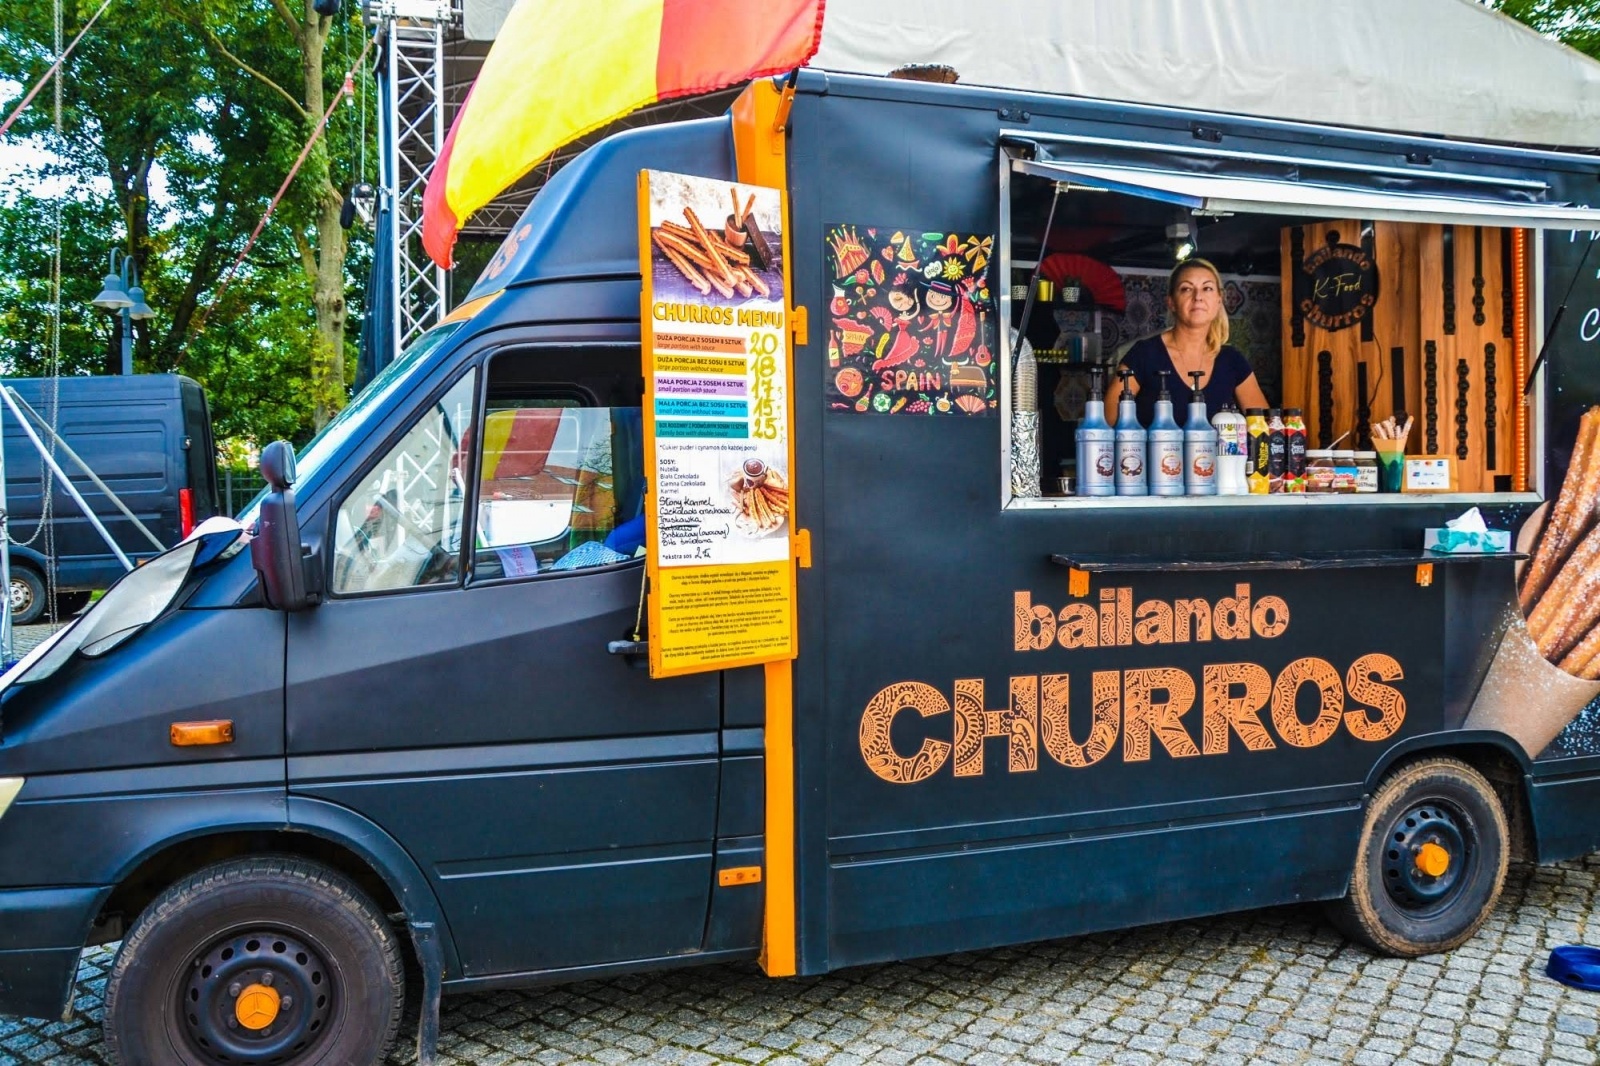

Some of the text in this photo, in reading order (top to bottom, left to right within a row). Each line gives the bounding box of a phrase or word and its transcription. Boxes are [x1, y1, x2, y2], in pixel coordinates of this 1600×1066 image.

[1303, 246, 1370, 275] bailando
[653, 302, 783, 329] CHURROS MENU
[1301, 293, 1374, 327] churros
[750, 332, 778, 356] 20
[845, 332, 865, 342] SPAIN
[750, 356, 776, 380] 18
[751, 379, 774, 399] 17
[880, 370, 941, 391] SPAIN
[753, 397, 775, 417] 15
[752, 418, 777, 440] 25
[1014, 583, 1290, 652] bailando
[859, 653, 1407, 783] CHURROS
